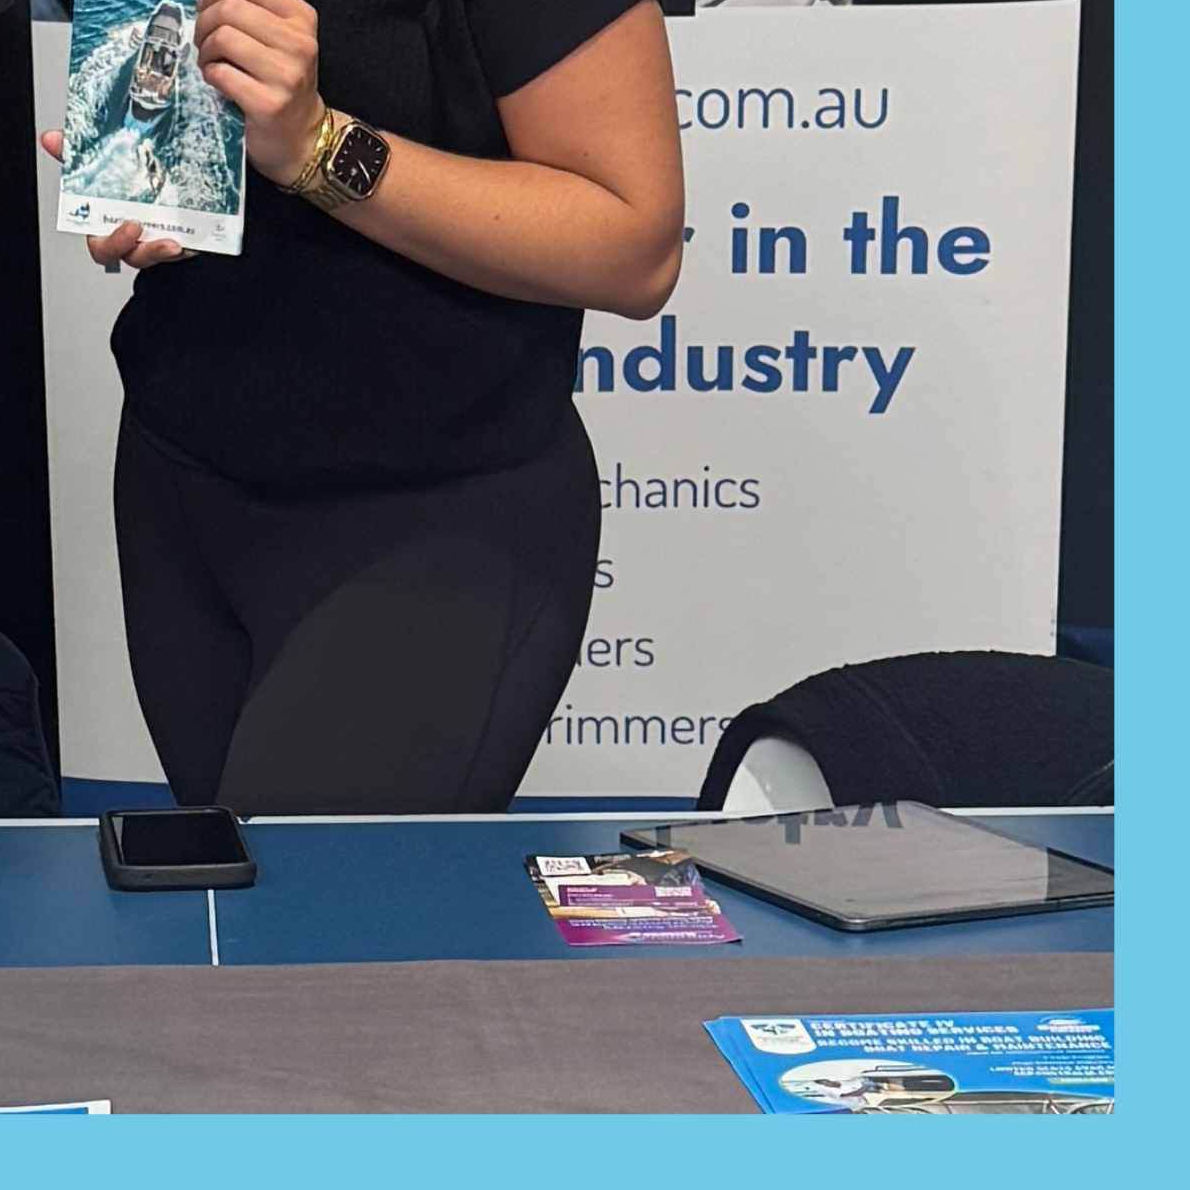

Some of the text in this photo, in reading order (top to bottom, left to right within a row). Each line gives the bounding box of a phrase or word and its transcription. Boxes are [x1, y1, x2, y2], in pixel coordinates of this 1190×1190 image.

[731, 195, 991, 276] in the
[573, 314, 916, 414] ndustry
[600, 462, 760, 509] hanics
[545, 703, 735, 745] rimmer
